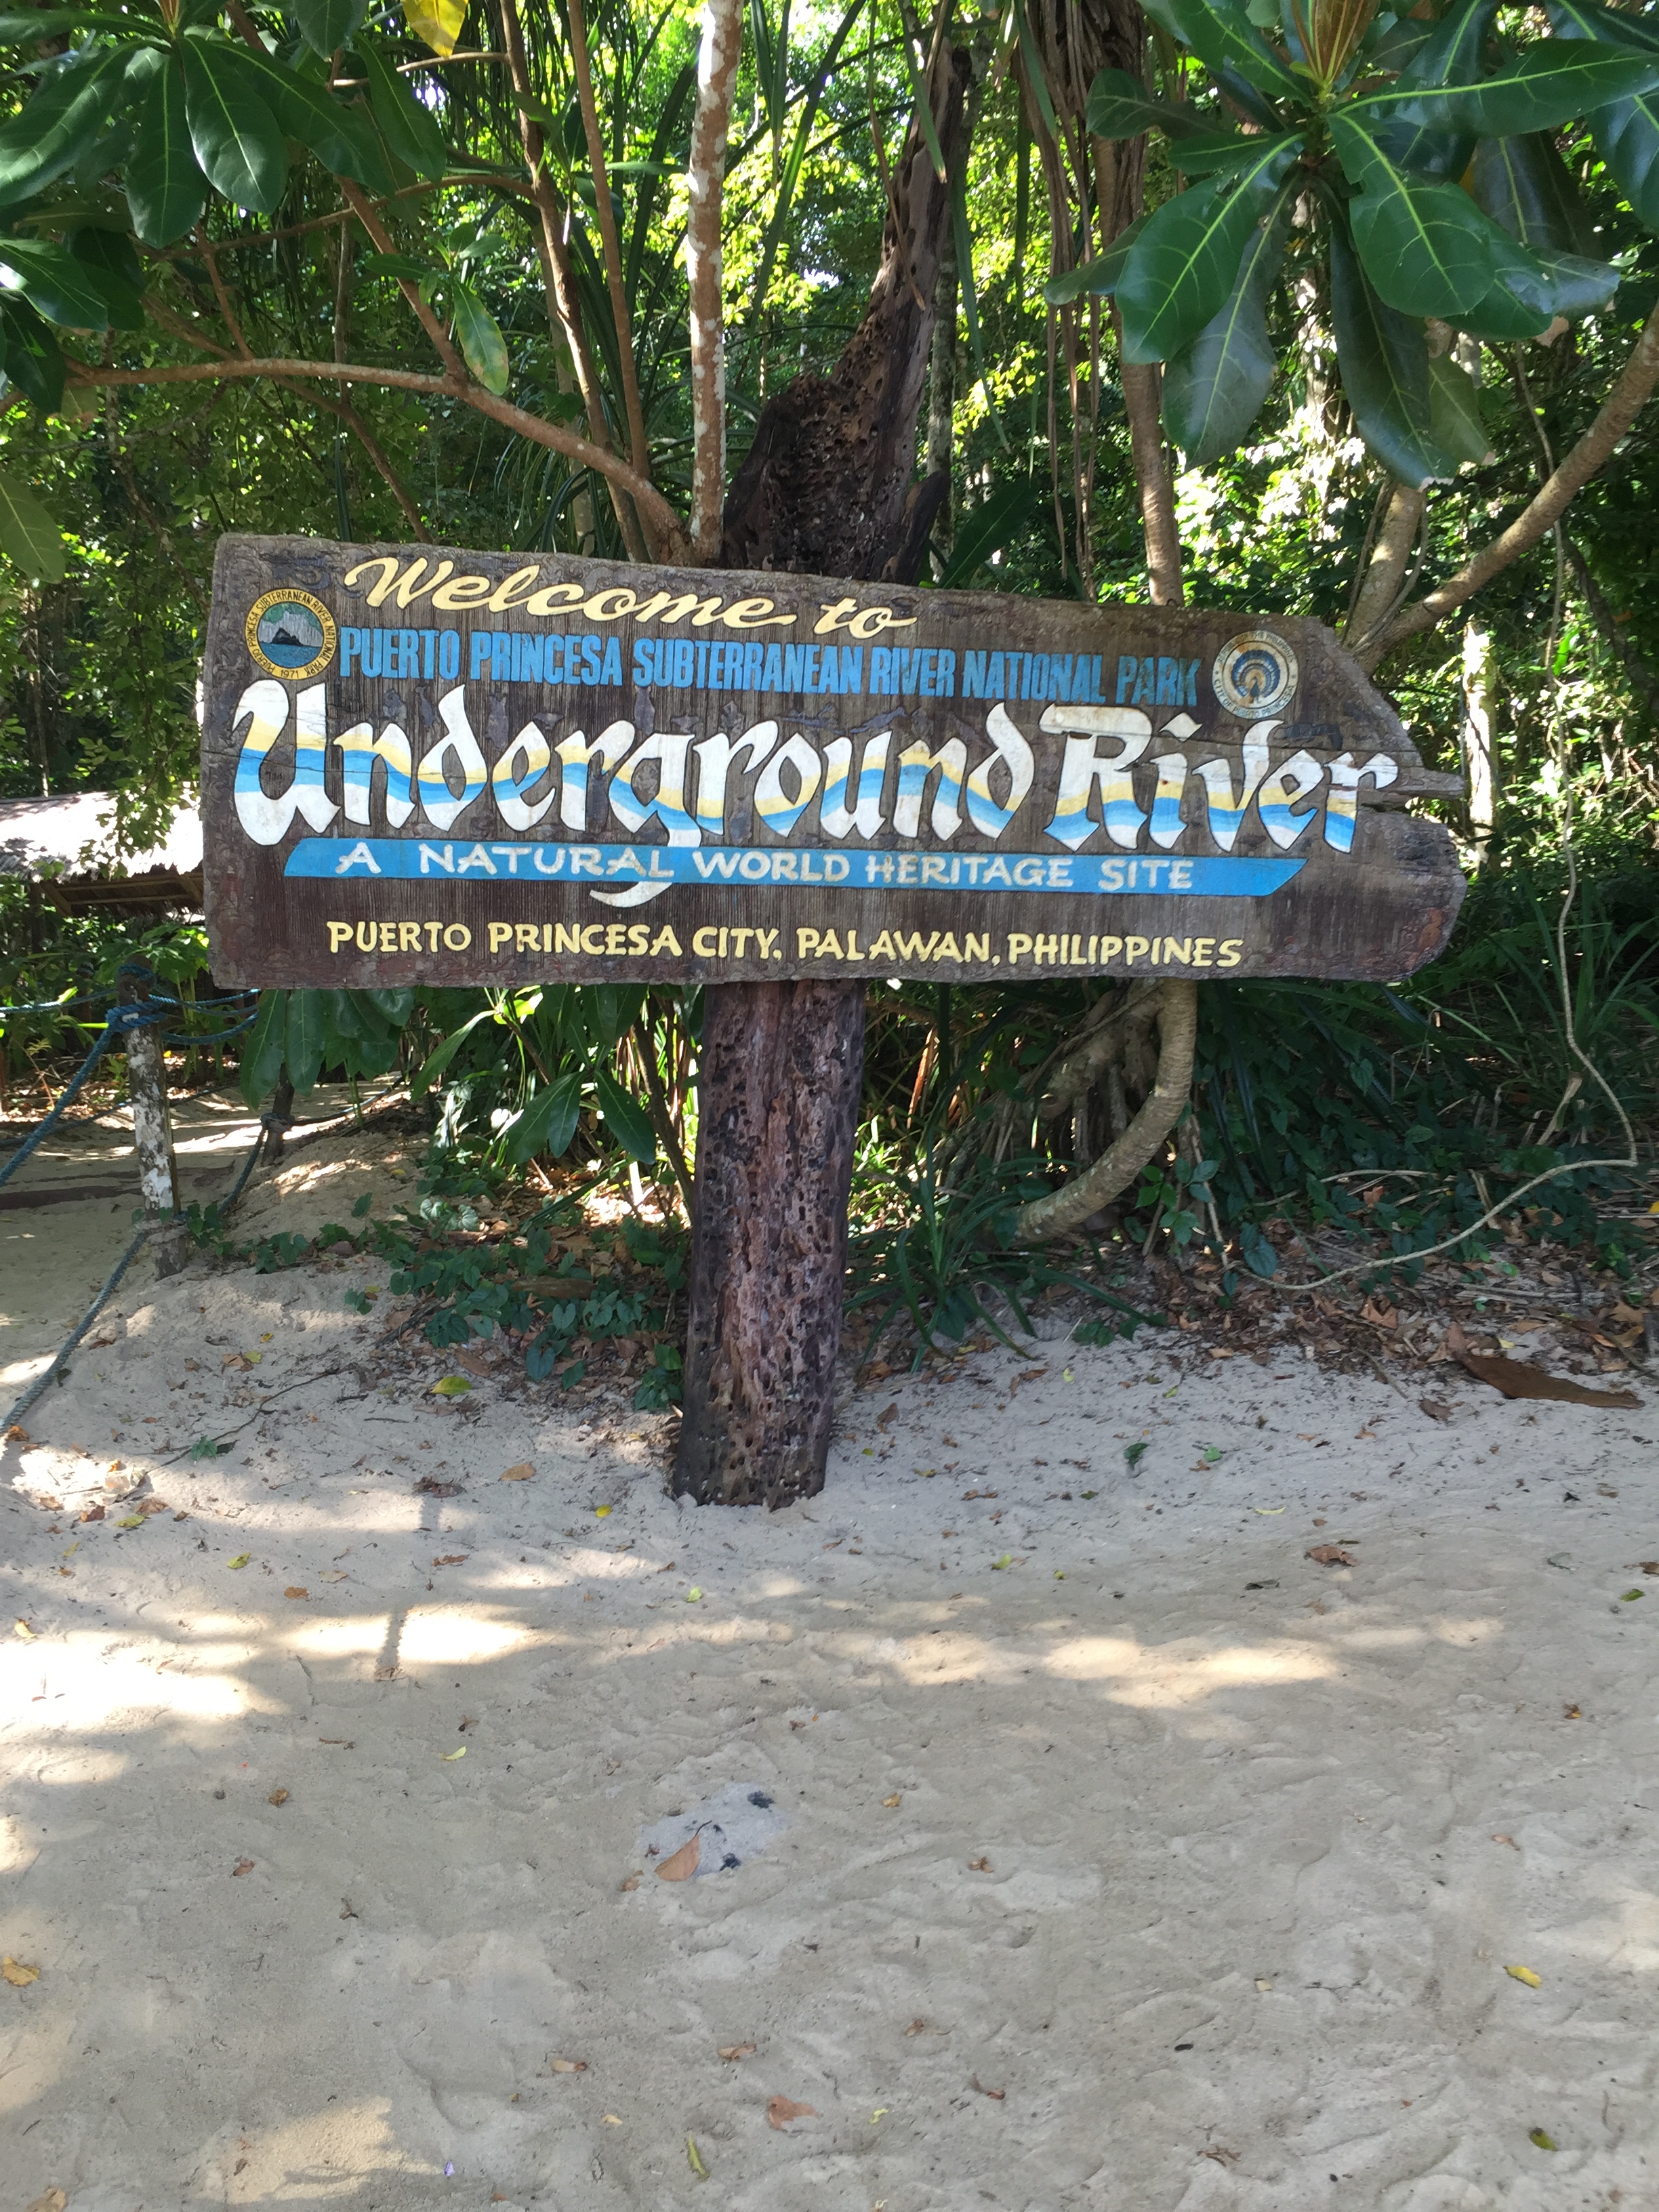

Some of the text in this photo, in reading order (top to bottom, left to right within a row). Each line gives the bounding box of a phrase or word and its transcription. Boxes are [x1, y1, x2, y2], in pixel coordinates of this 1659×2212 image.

[247, 590, 335, 676] PUERTO PRINCESA SUBTERRANEAN RIVER NATIONAL PARK
[343, 556, 918, 639] Welcome to
[281, 670, 300, 679] 1971
[340, 626, 1202, 707] PUERTO PRINCESA SUBTERRANEAN RIVER NATIONAL PARK
[232, 678, 1399, 908] Underground River
[335, 841, 1194, 890] A NATURAL WORLD HERITAGE SITE
[325, 920, 472, 954] PUERTO
[487, 921, 683, 956] PRINCESA
[1008, 933, 1244, 968] PHILIPPINES
